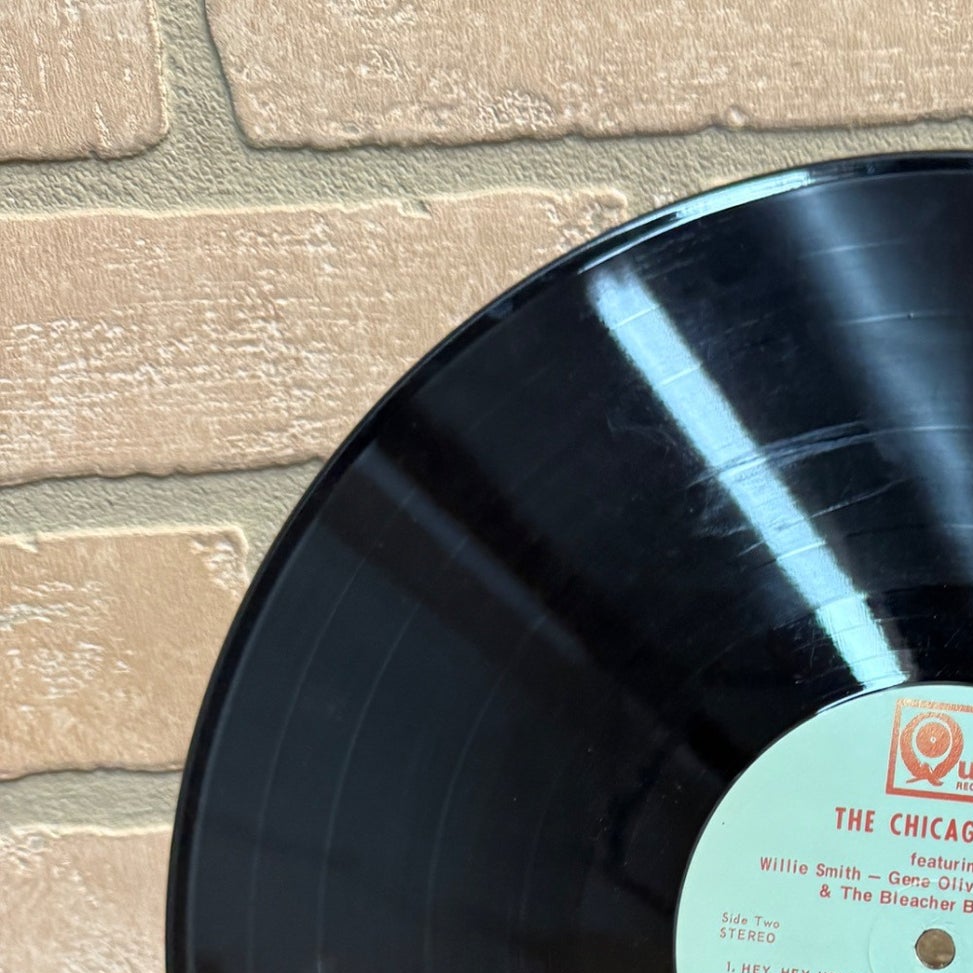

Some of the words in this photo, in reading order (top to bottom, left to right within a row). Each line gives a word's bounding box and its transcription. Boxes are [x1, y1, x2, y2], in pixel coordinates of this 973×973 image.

[835, 806, 876, 833] THE
[760, 856, 809, 875] Willie
[816, 863, 861, 881] Smith
[819, 883, 832, 898] &
[840, 885, 873, 902] The
[879, 890, 957, 911] Bleacher
[722, 912, 748, 925] Side
[754, 915, 780, 929] Two
[719, 927, 776, 943] STEREO
[727, 961, 736, 972] 1.
